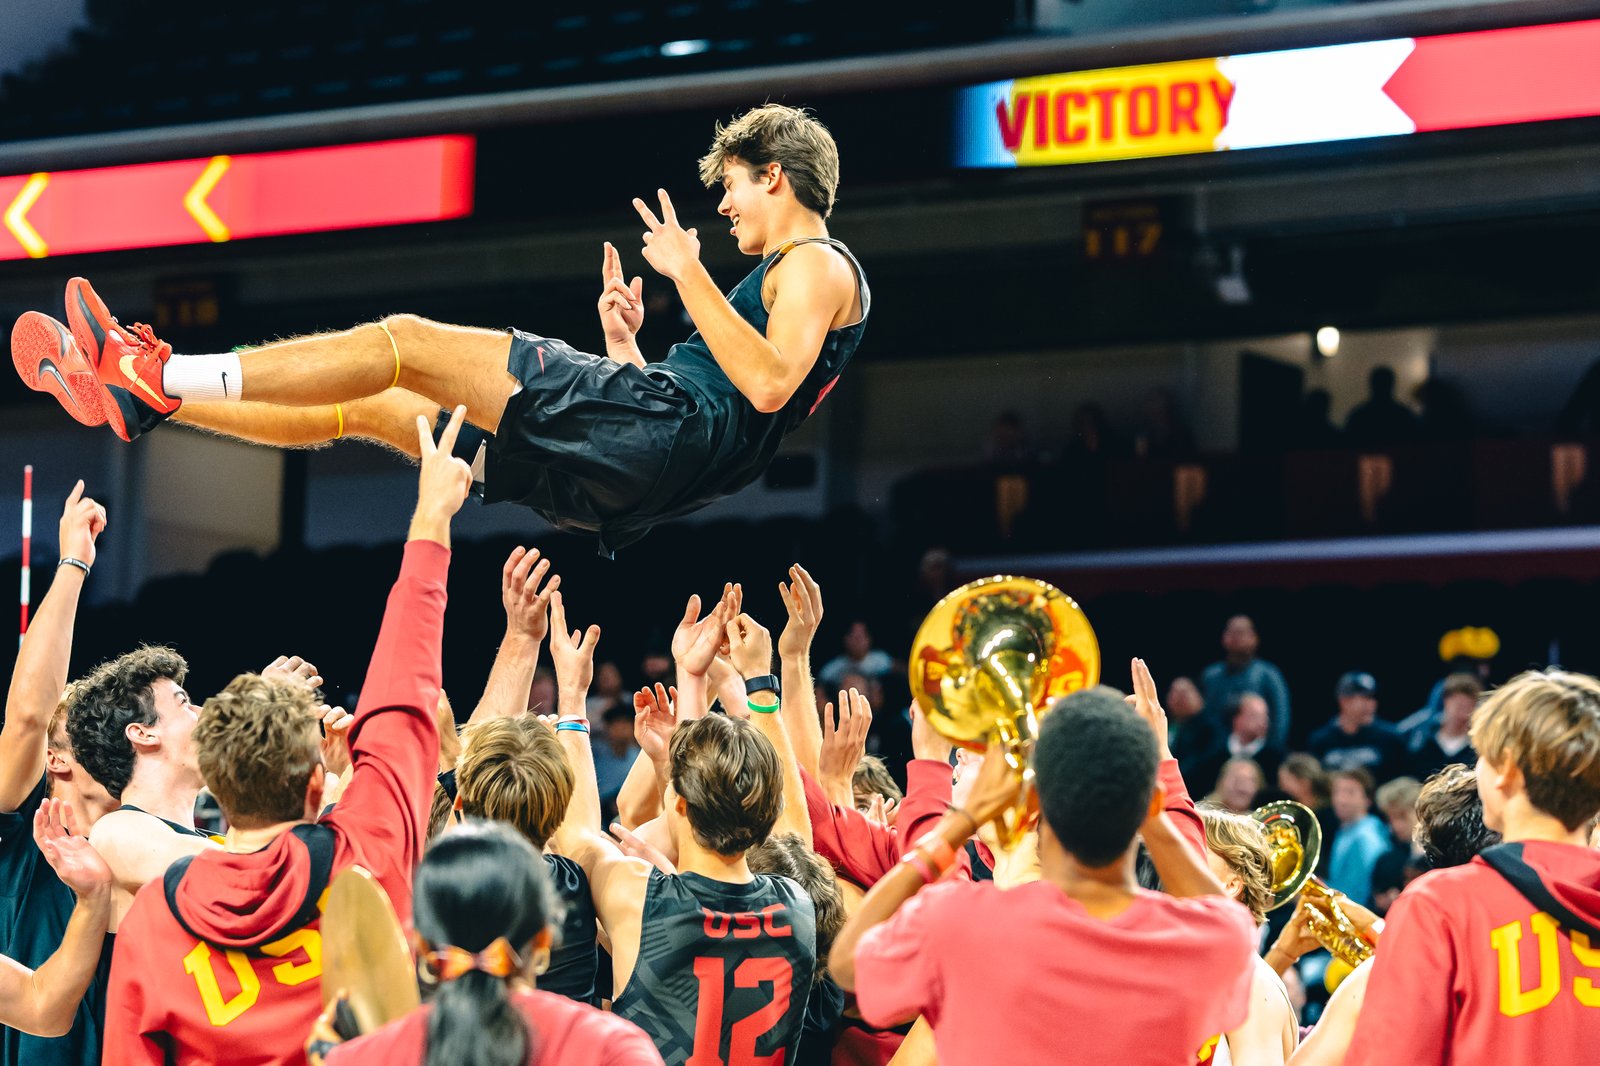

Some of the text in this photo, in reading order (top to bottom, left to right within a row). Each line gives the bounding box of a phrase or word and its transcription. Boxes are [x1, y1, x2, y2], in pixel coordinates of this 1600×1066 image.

[996, 79, 1236, 151] VICTORY
[183, 886, 331, 1026] US
[702, 903, 792, 939] USC
[685, 957, 793, 1066] 12
